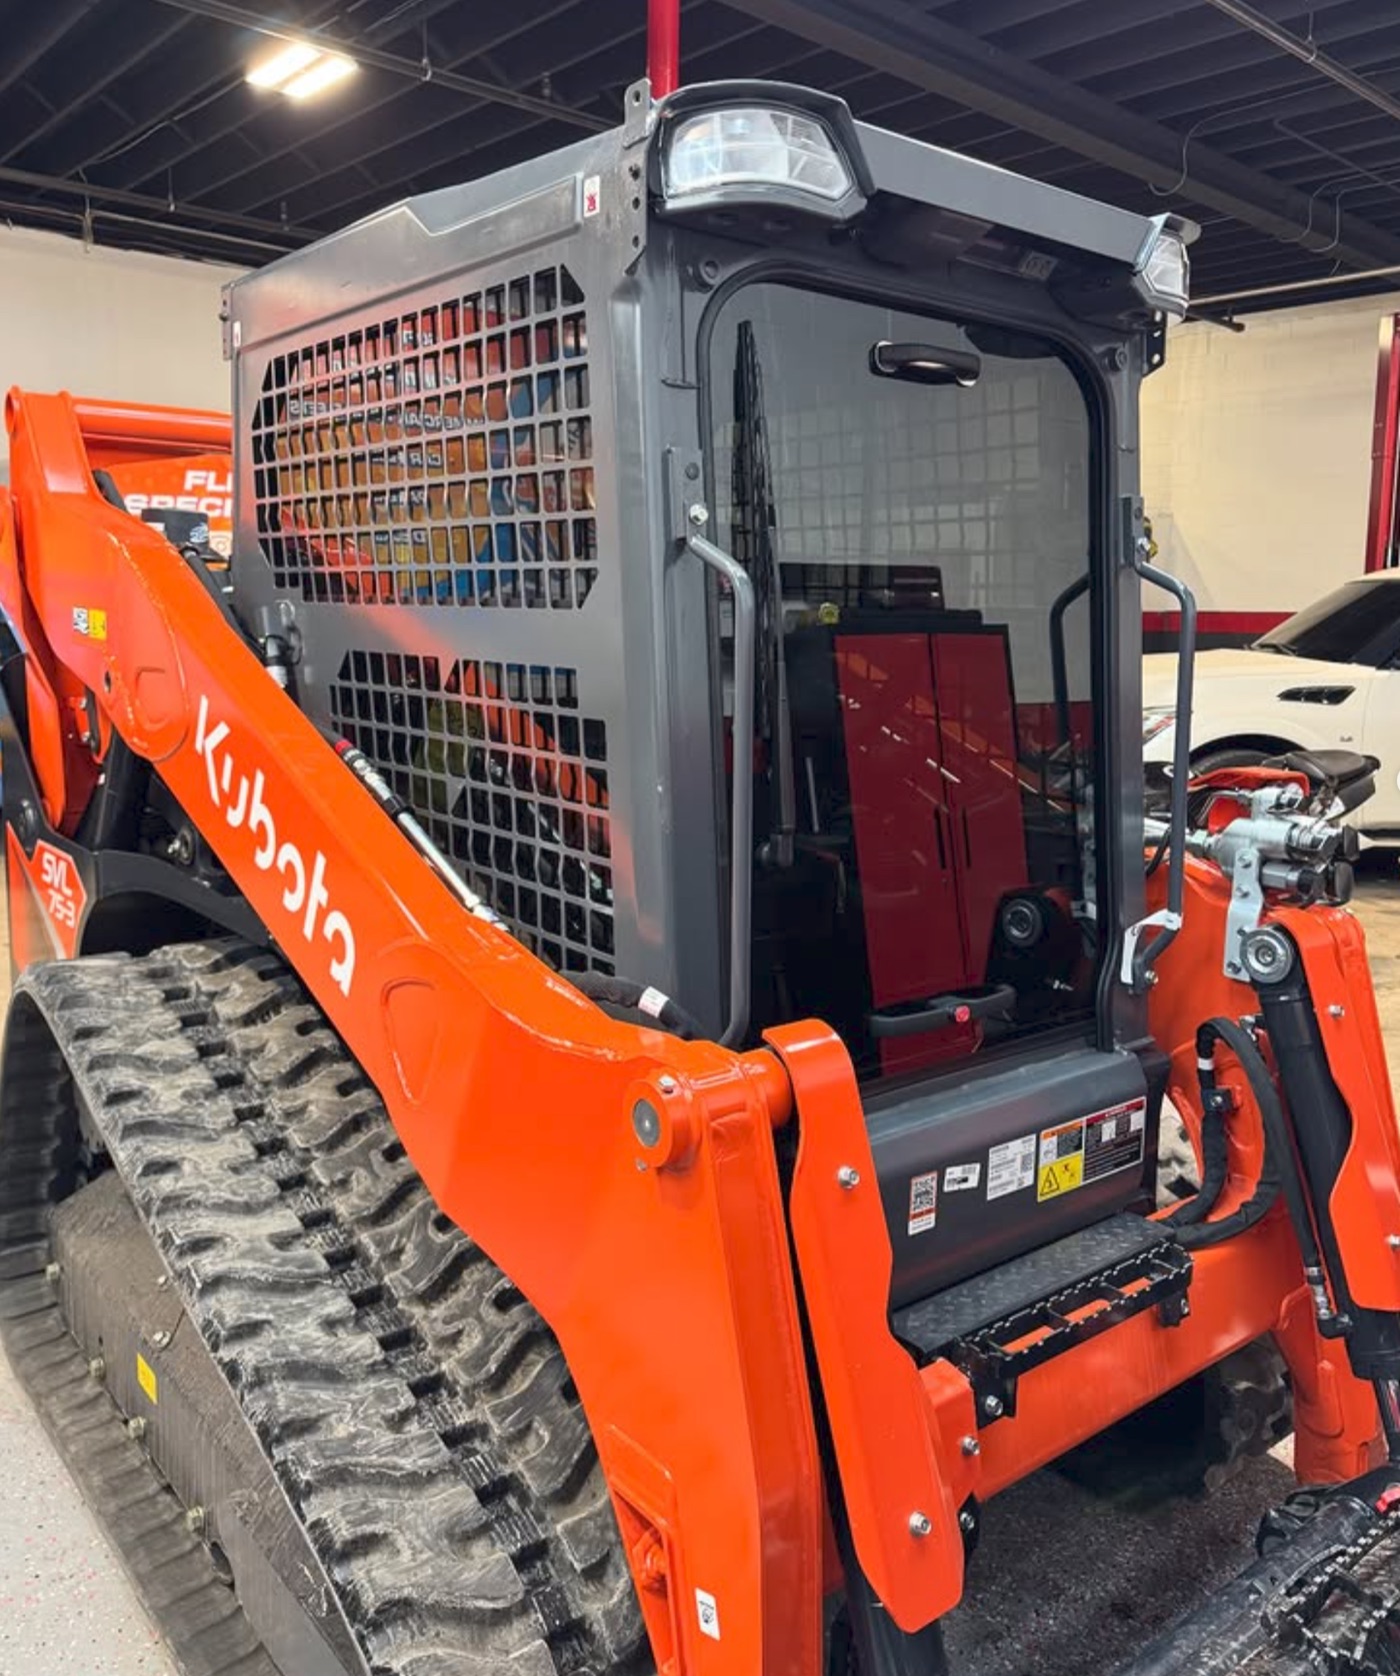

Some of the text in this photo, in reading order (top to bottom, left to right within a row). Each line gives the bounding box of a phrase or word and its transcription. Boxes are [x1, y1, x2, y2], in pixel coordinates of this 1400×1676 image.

[195, 695, 356, 997] Kubota
[41, 851, 73, 897] SVL
[48, 888, 76, 929] 75-3
